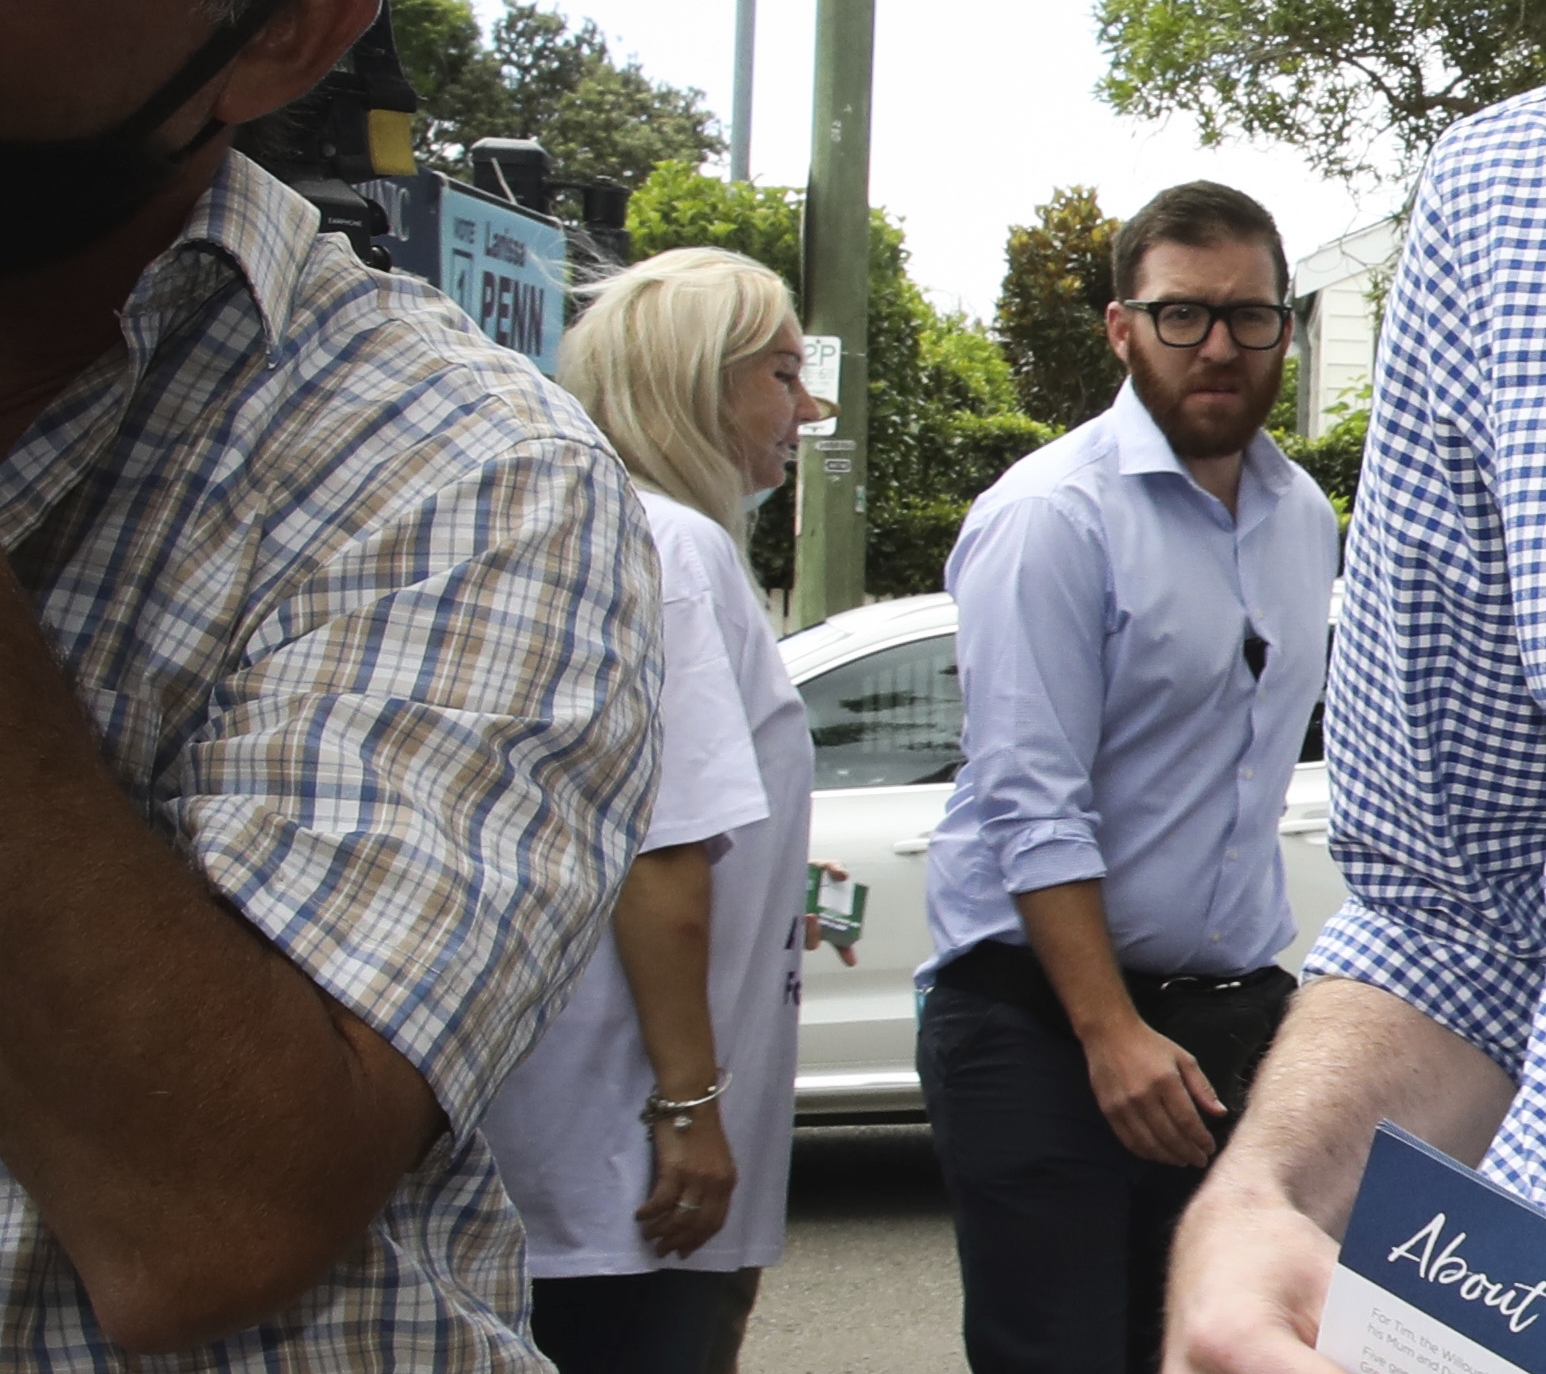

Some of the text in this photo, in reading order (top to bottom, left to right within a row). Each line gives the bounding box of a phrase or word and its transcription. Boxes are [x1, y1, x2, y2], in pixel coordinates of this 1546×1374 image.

[480, 271, 545, 358] PENN
[1365, 1322, 1386, 1340] his
[1384, 1333, 1417, 1358] Mum
[1415, 1351, 1440, 1372] and
[1369, 1306, 1392, 1326] For
[1391, 1320, 1420, 1343] Tim,
[1417, 1334, 1440, 1353] the
[1360, 1346, 1388, 1367] Five
